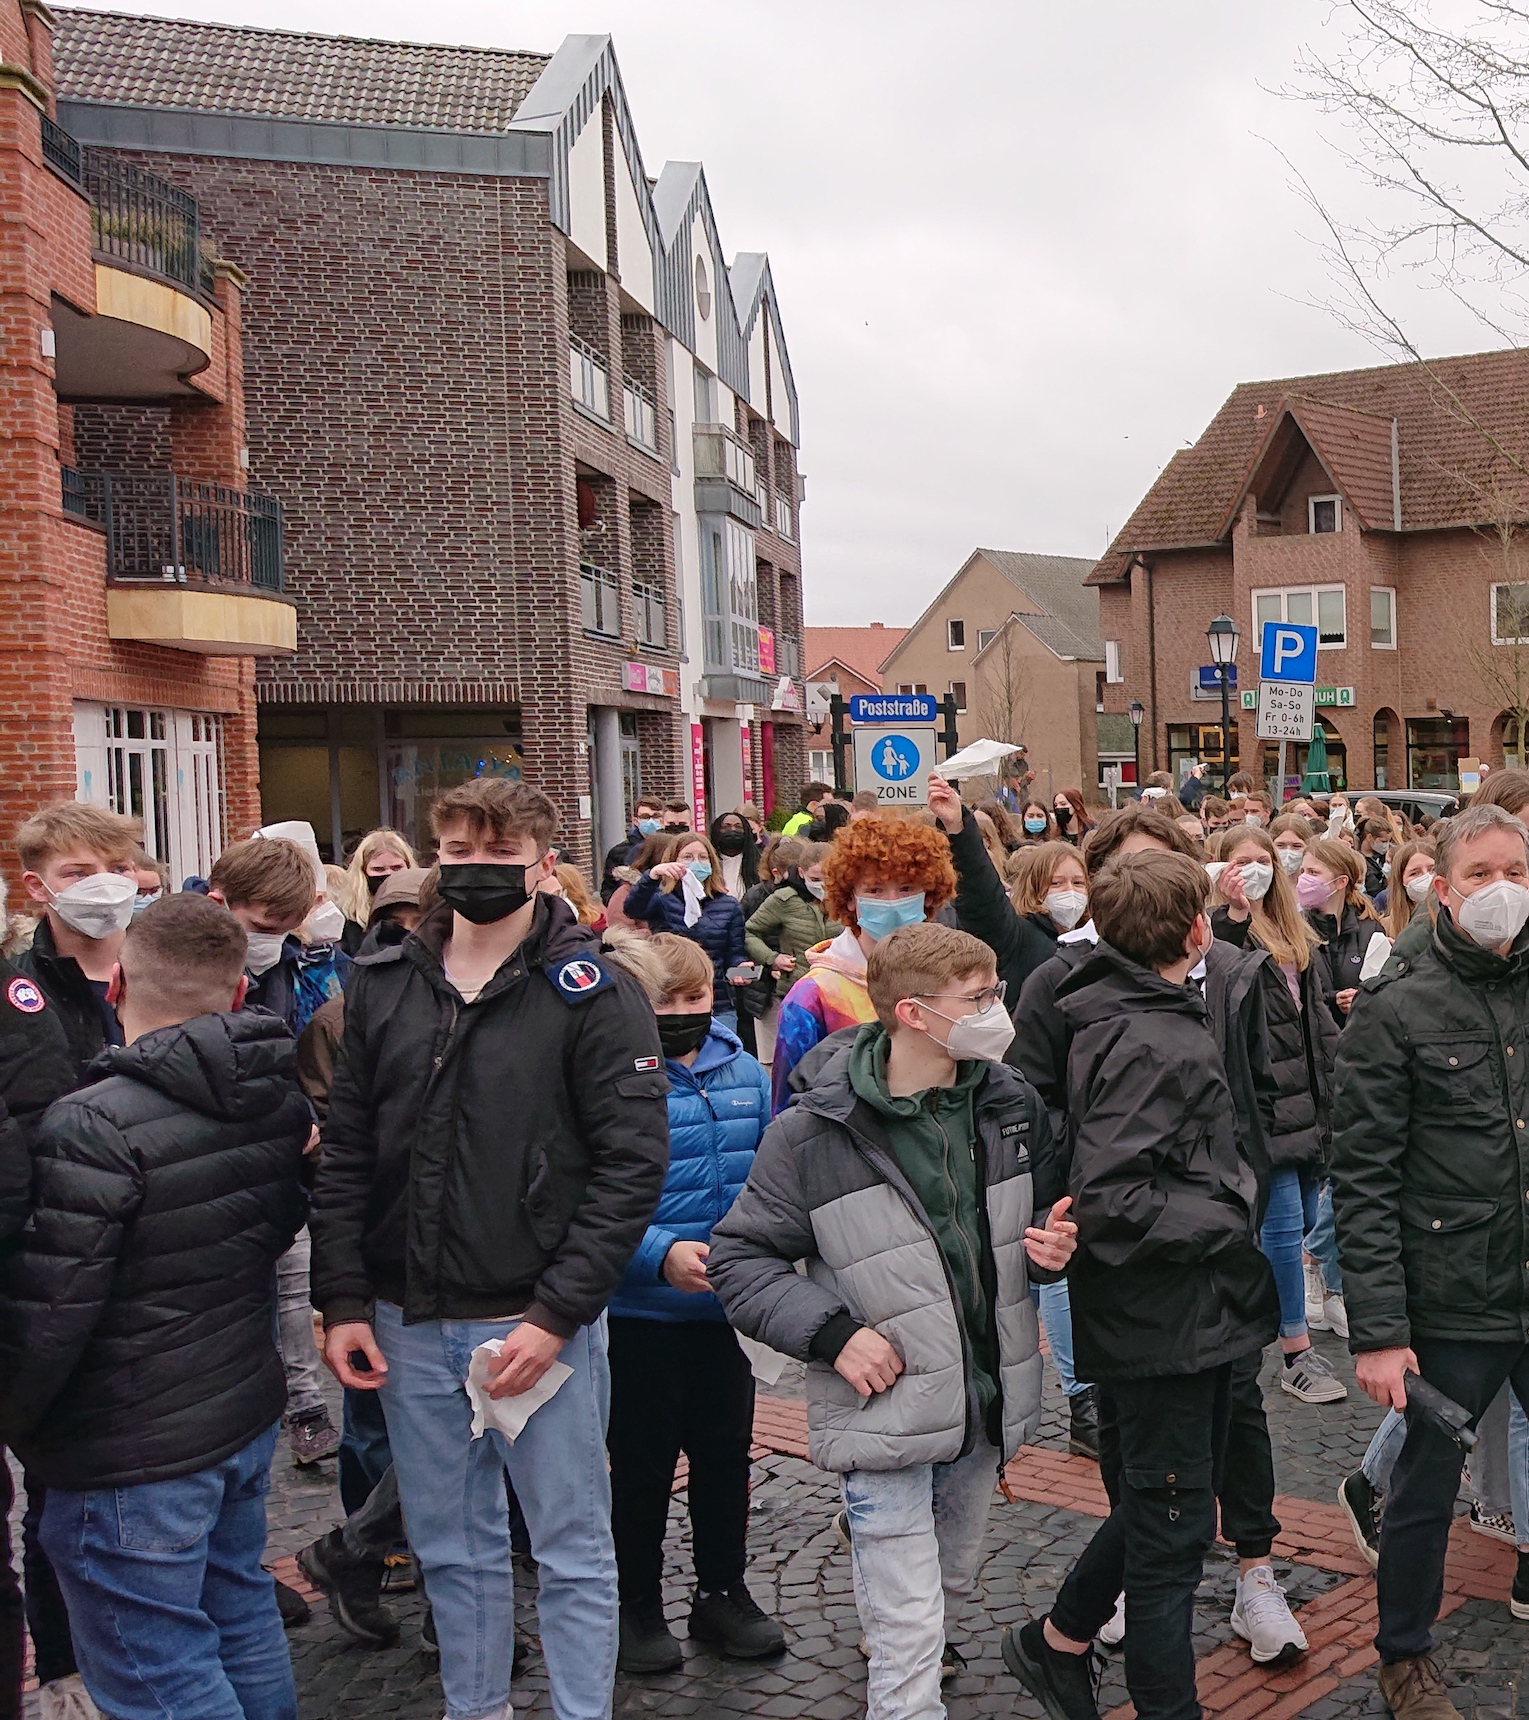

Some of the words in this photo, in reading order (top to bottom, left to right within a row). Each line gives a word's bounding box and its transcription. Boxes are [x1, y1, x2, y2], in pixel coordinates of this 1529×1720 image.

[1274, 630, 1304, 673] P
[1269, 686, 1303, 698] Mo-Do
[859, 699, 928, 716] Poststraße
[1270, 700, 1301, 710] Sa-So
[1265, 712, 1276, 722] Fr
[1281, 713, 1304, 723] 0-6h
[1267, 725, 1301, 736] 13-24h
[877, 786, 917, 798] ZONE
